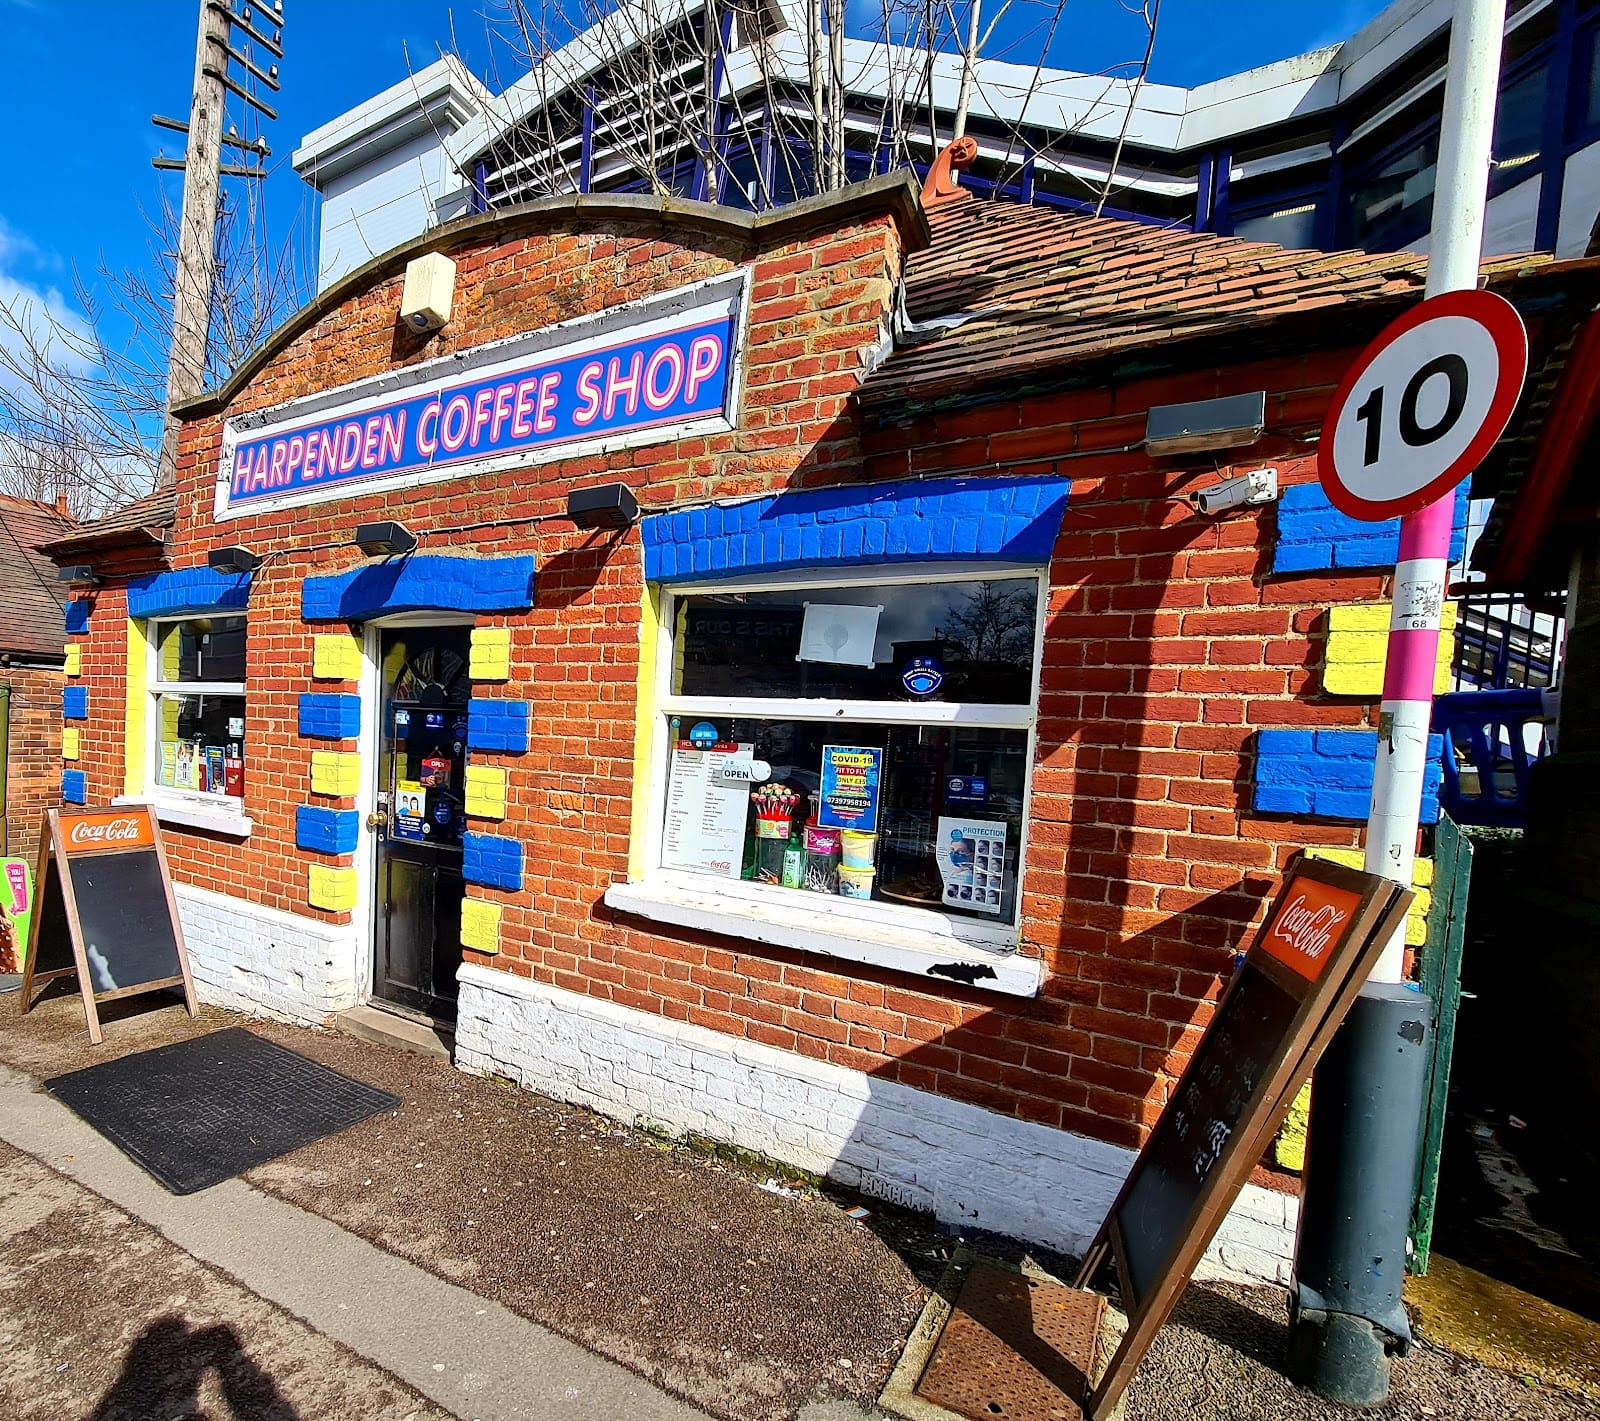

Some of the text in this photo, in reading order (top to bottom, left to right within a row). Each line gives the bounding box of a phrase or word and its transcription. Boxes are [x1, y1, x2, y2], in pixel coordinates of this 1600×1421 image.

[234, 333, 722, 494] HARPENDEN COFFEE SHOP
[1356, 353, 1468, 467] 10
[1412, 619, 1427, 629] 68
[832, 755, 873, 765] COVID-19
[724, 769, 749, 779] OPEN
[962, 826, 1005, 838] PROTECTION
